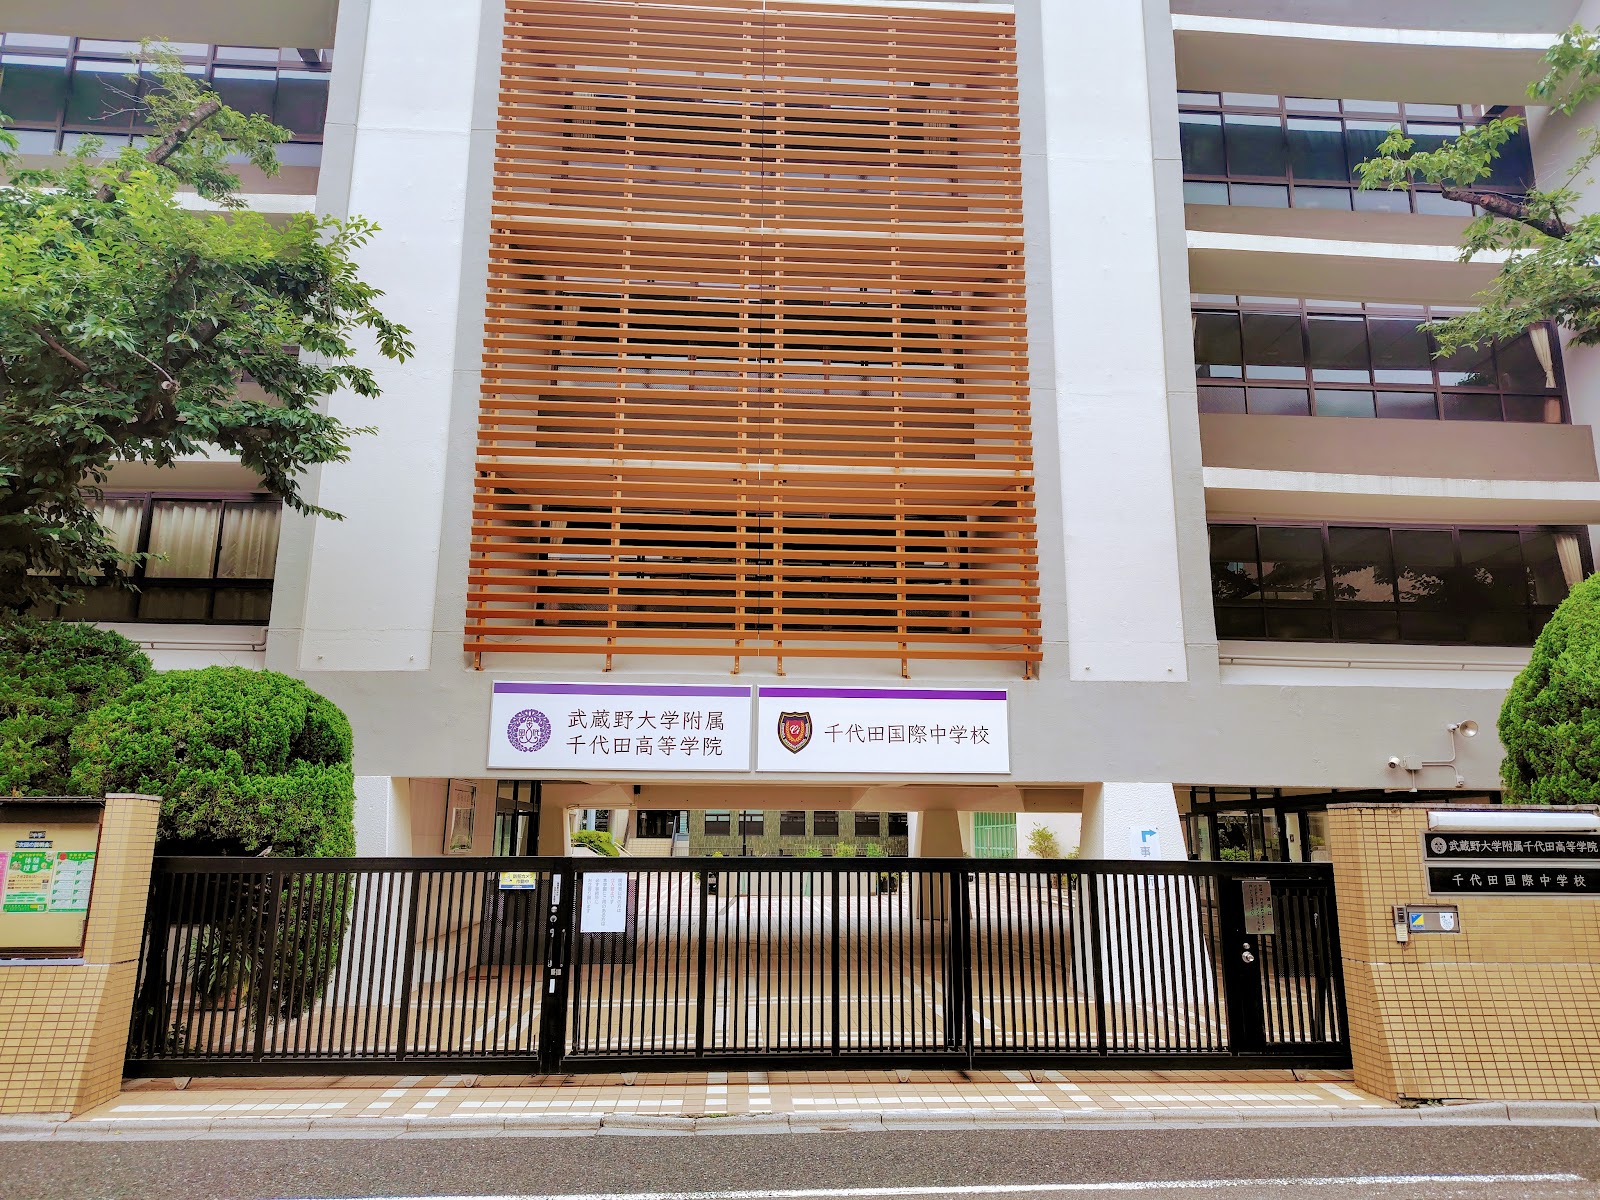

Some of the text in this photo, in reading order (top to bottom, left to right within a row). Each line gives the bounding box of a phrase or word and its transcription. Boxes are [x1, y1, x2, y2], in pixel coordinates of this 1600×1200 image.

[567, 708, 725, 731] 武蔵野大学附属
[565, 734, 724, 757] 千代田高等学院
[824, 723, 991, 746] 千代田国際中学校
[1448, 840, 1599, 853] 武蔵野大学附属千代田高等学院
[1451, 873, 1587, 887] 千代田国際中学校
